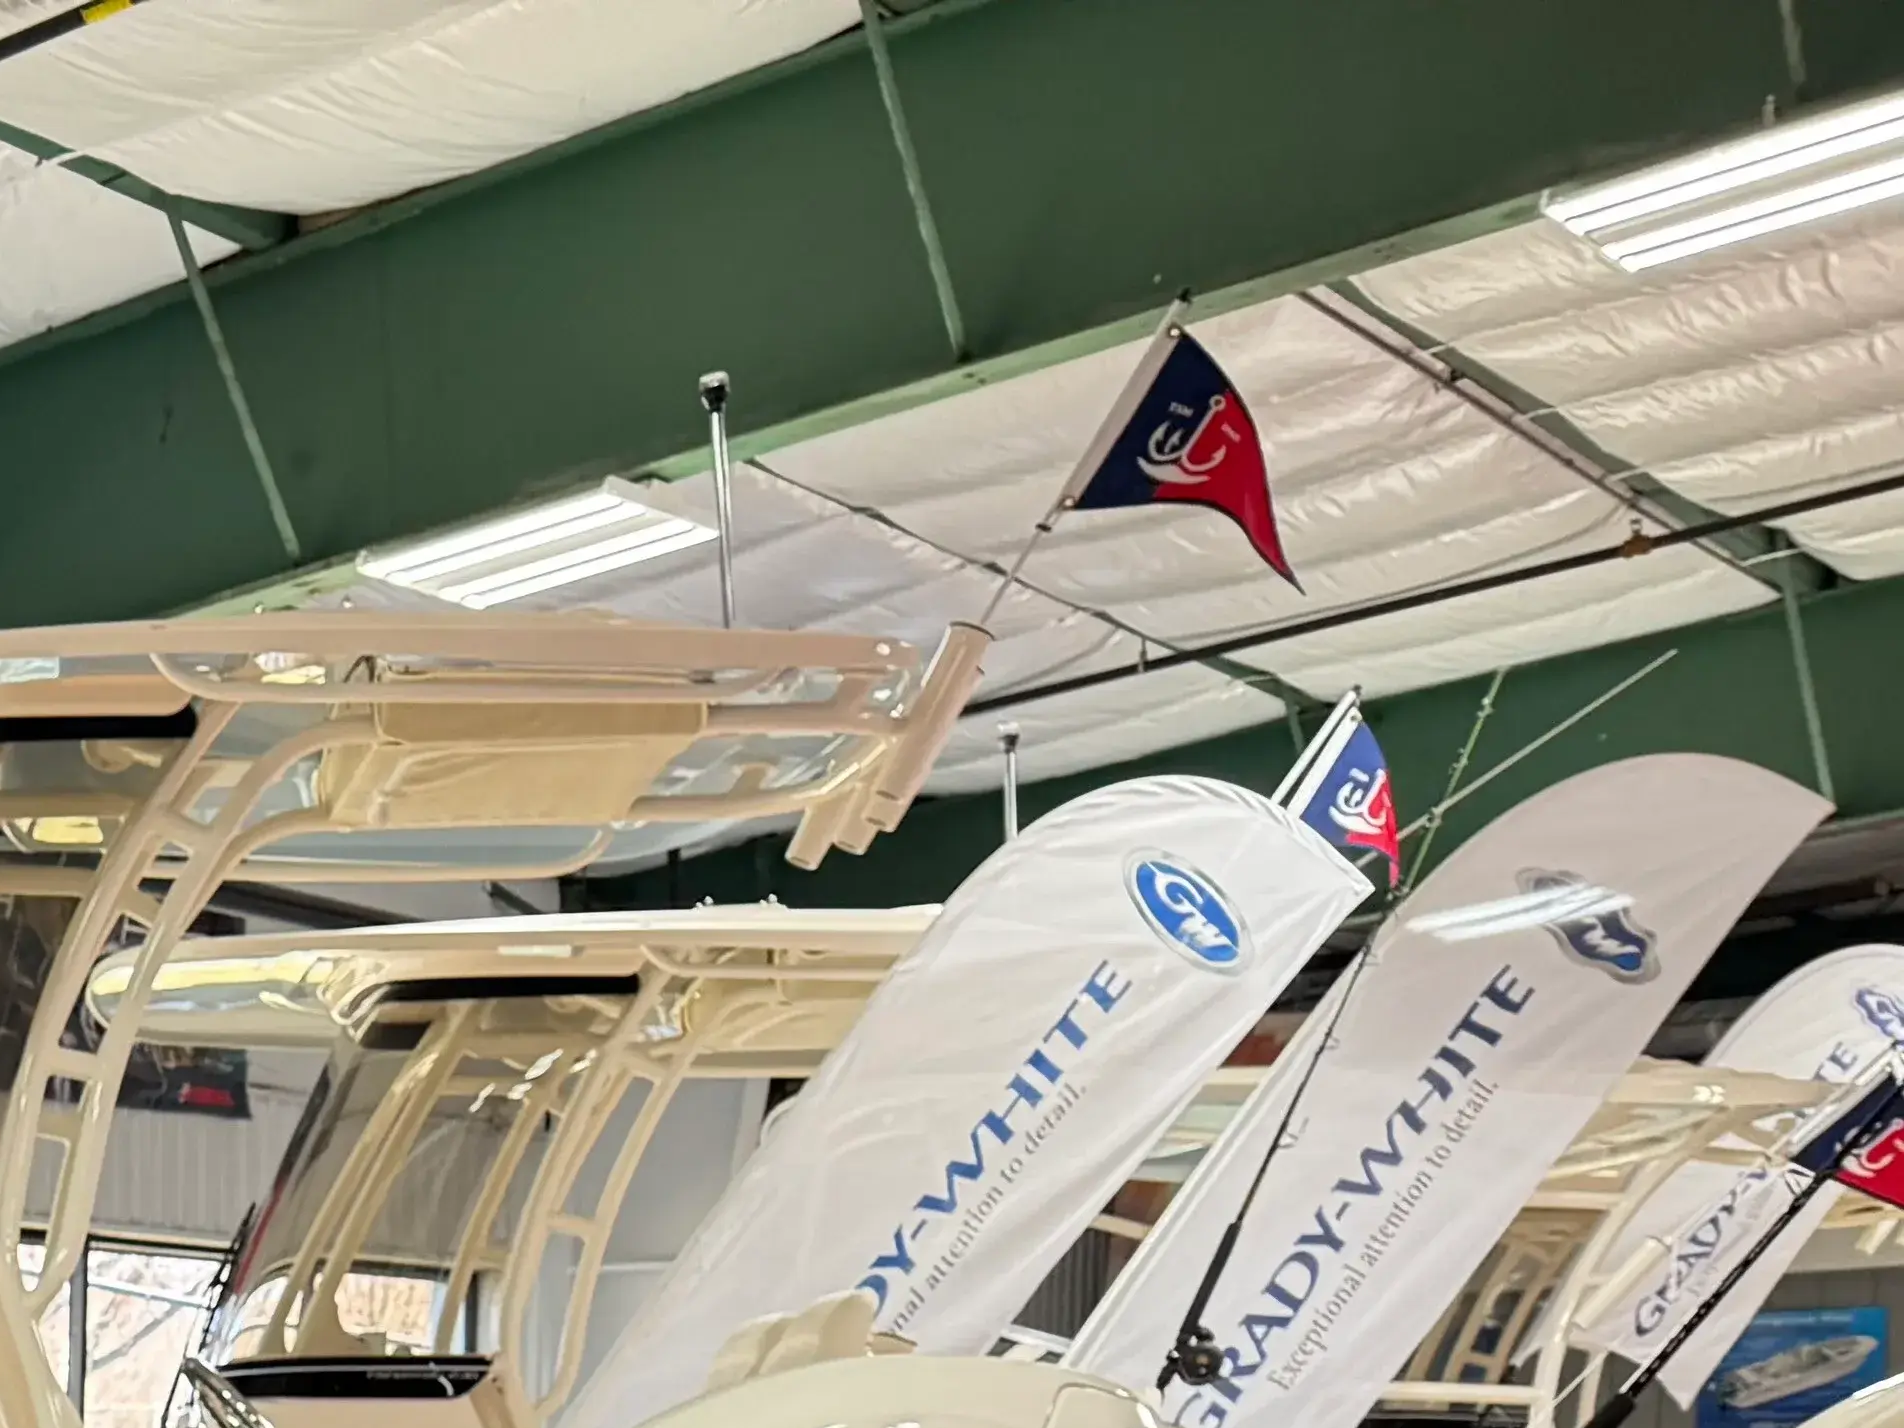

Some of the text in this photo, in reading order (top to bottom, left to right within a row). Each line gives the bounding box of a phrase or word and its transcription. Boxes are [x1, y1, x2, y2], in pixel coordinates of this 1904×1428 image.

[927, 1185, 1004, 1294] attention
[1000, 1155, 1026, 1186] to
[1267, 1262, 1368, 1392] Exceptional
[1360, 1167, 1436, 1269] attention
[1425, 1144, 1454, 1175] to
